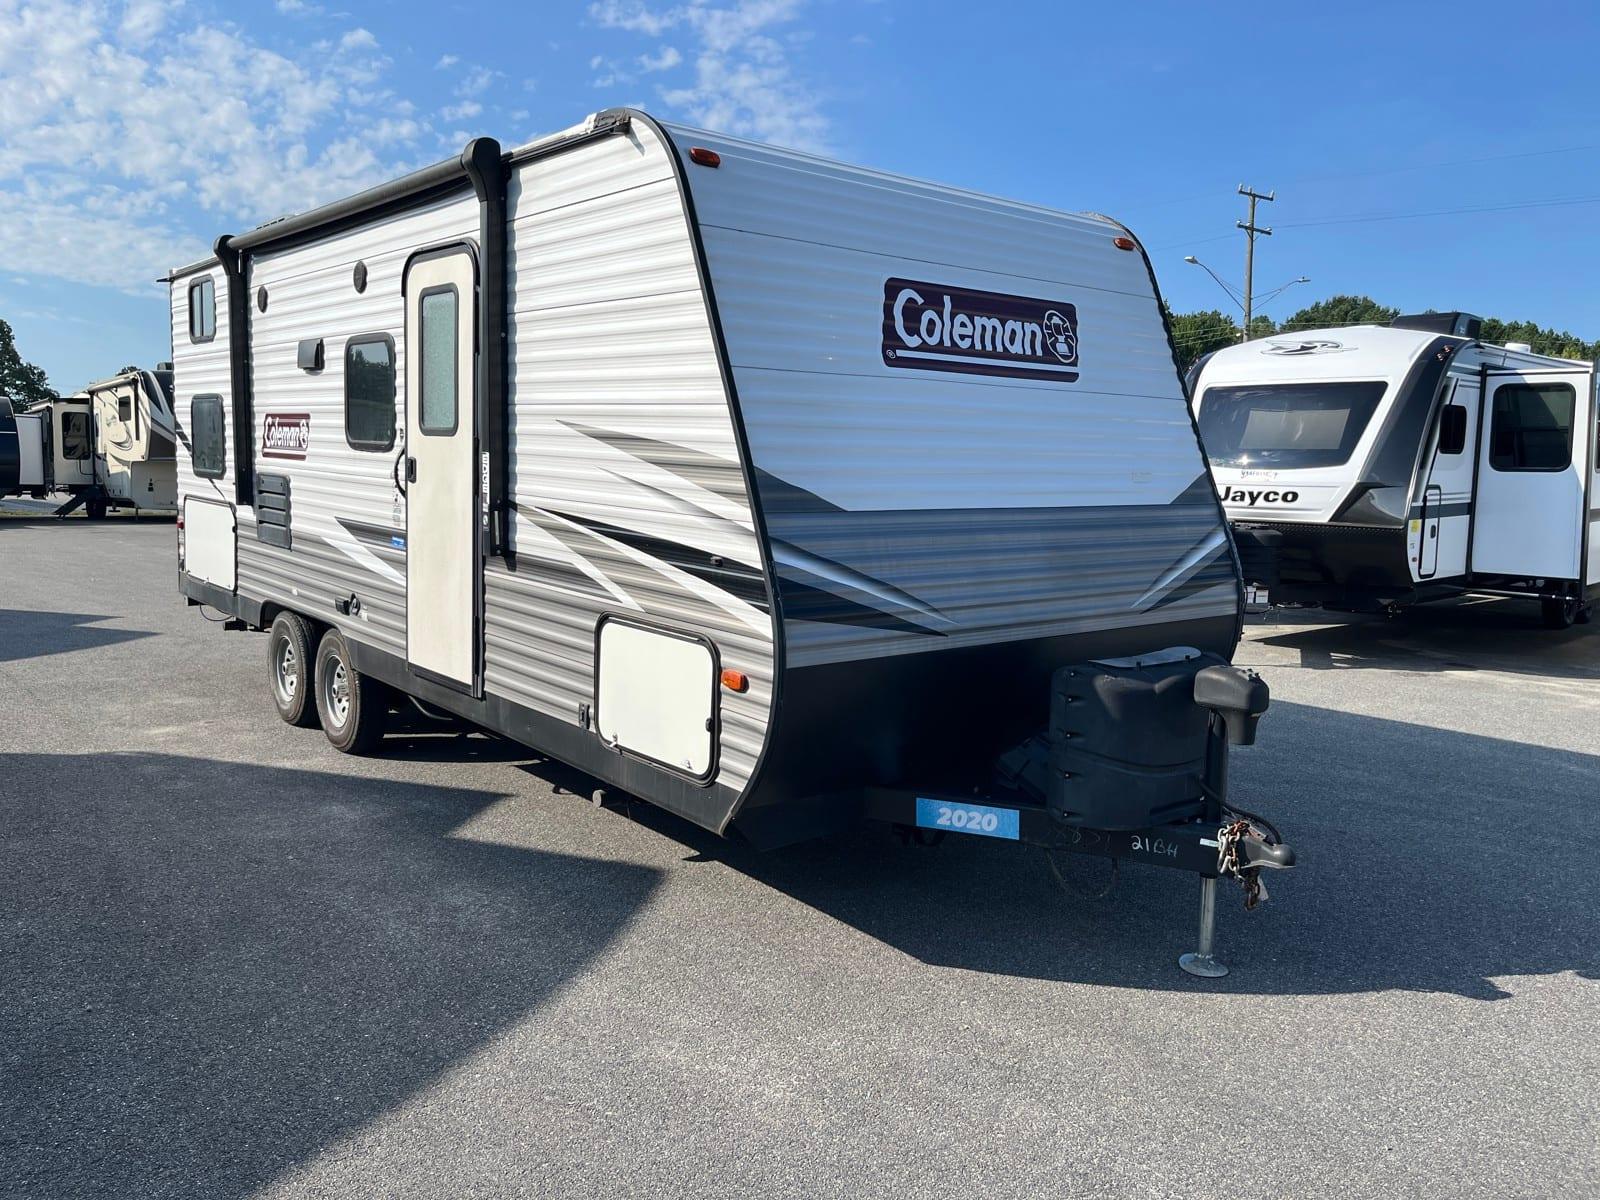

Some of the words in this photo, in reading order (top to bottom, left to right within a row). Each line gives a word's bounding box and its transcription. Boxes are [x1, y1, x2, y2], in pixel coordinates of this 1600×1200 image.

[893, 288, 1043, 357] Coleman
[265, 416, 299, 447] Coleman
[1220, 486, 1299, 506] Jayco
[937, 807, 998, 832] 2020
